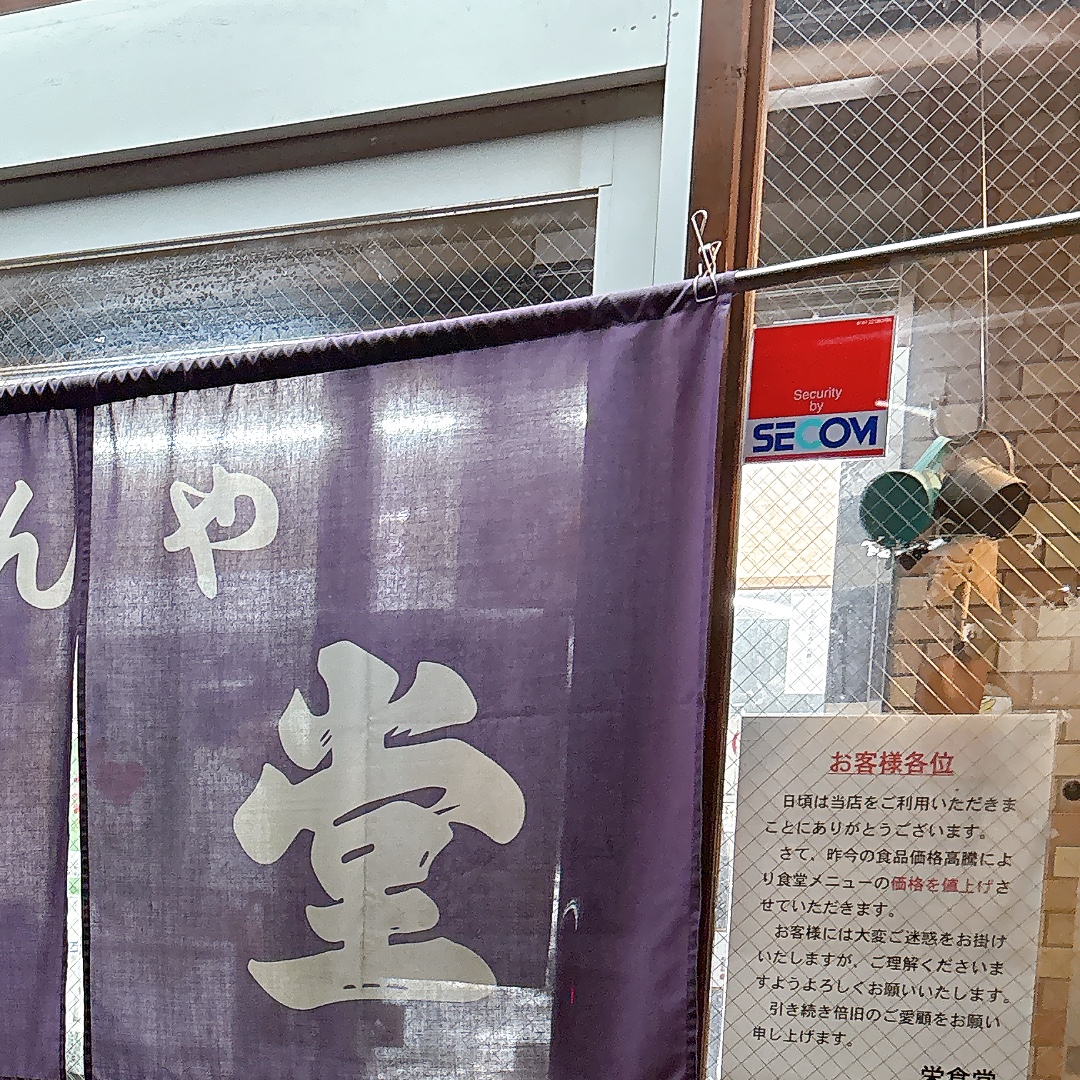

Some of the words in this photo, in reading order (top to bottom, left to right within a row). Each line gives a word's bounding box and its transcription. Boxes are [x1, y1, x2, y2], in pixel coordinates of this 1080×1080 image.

[793, 387, 843, 401] Security
[809, 399, 824, 413] by
[752, 415, 879, 453] SECOM
[828, 751, 955, 775] お客様各位
[782, 794, 1017, 813] 日頃は当店をご利用いただきま
[765, 820, 986, 840] ことにありがとうございます。
[760, 898, 895, 918] せていただきます。
[774, 924, 1007, 949] お客様には大変ご迷惑をお掛け
[756, 975, 1010, 1004] すようよろしくお願いいたします。
[769, 1002, 1001, 1029] 引き続き倍旧のご愛顧をお願い
[753, 1026, 853, 1047] 申し上げます。
